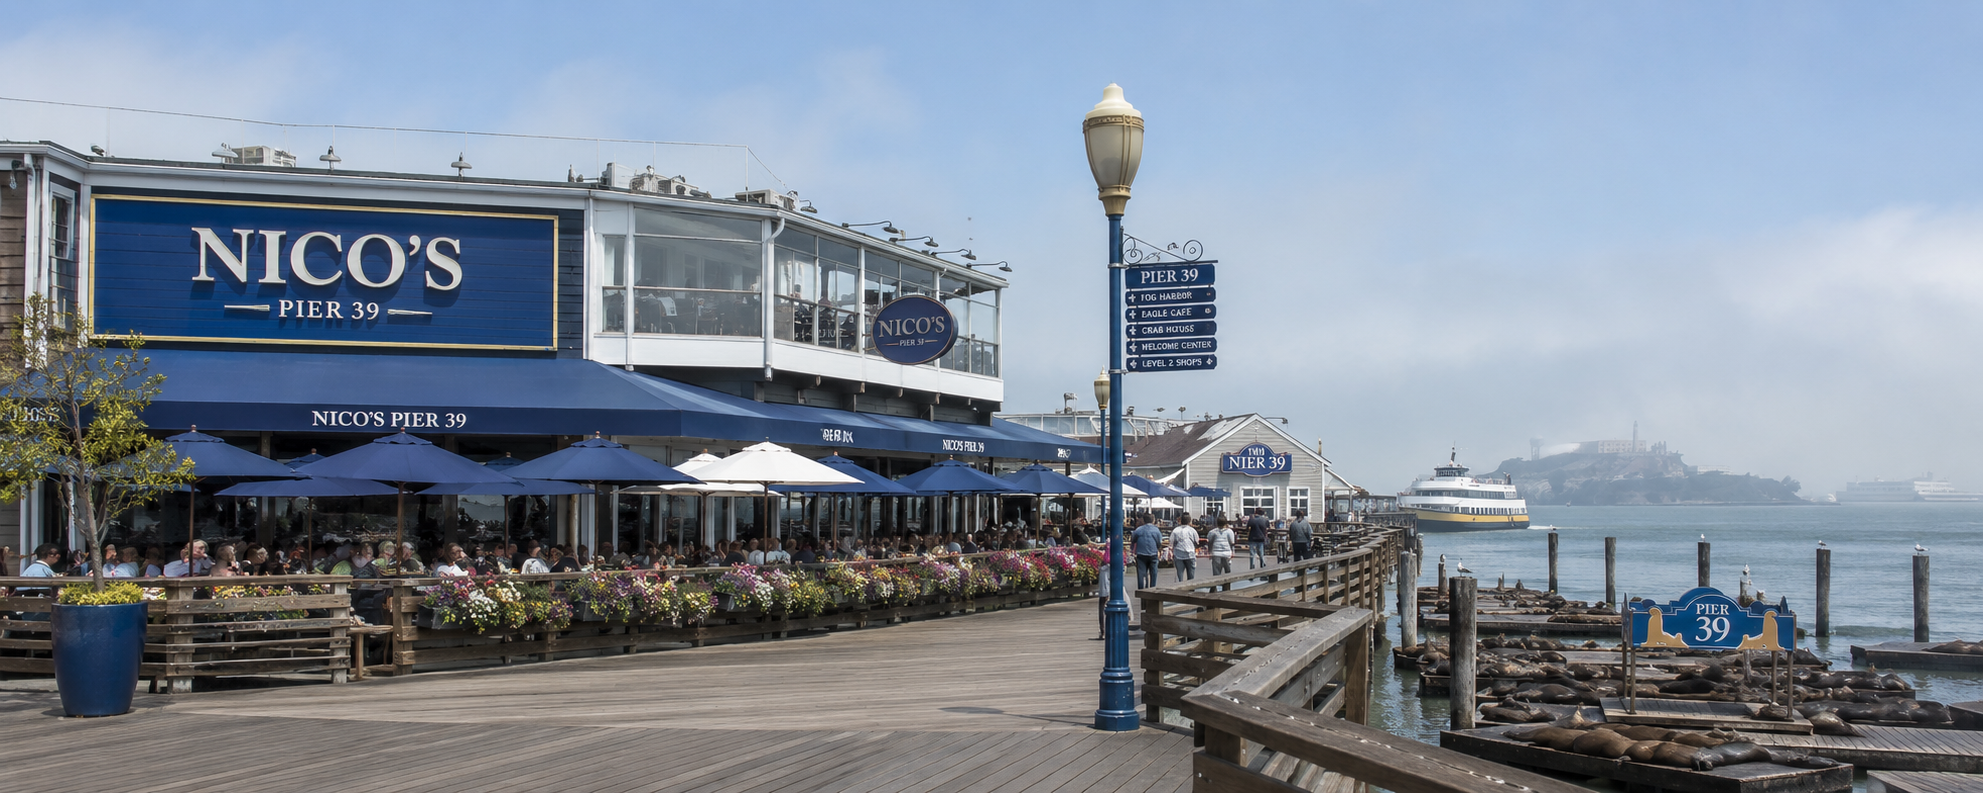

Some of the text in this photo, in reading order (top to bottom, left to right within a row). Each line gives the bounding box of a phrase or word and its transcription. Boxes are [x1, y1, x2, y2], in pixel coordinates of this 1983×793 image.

[191, 226, 463, 291] NICO'S
[1140, 267, 1199, 284] PIER 39
[278, 299, 380, 320] PIER 39
[877, 316, 945, 338] NICO'S
[1141, 326, 1164, 335] CRAB
[899, 339, 916, 347] PIER
[1142, 357, 1202, 368] LEVEL 2 SHOPS
[312, 410, 467, 429] NICO'S PIER 39
[1228, 456, 1286, 471] NIER 39
[1695, 603, 1730, 616] PIER
[1695, 616, 1731, 643] 39
